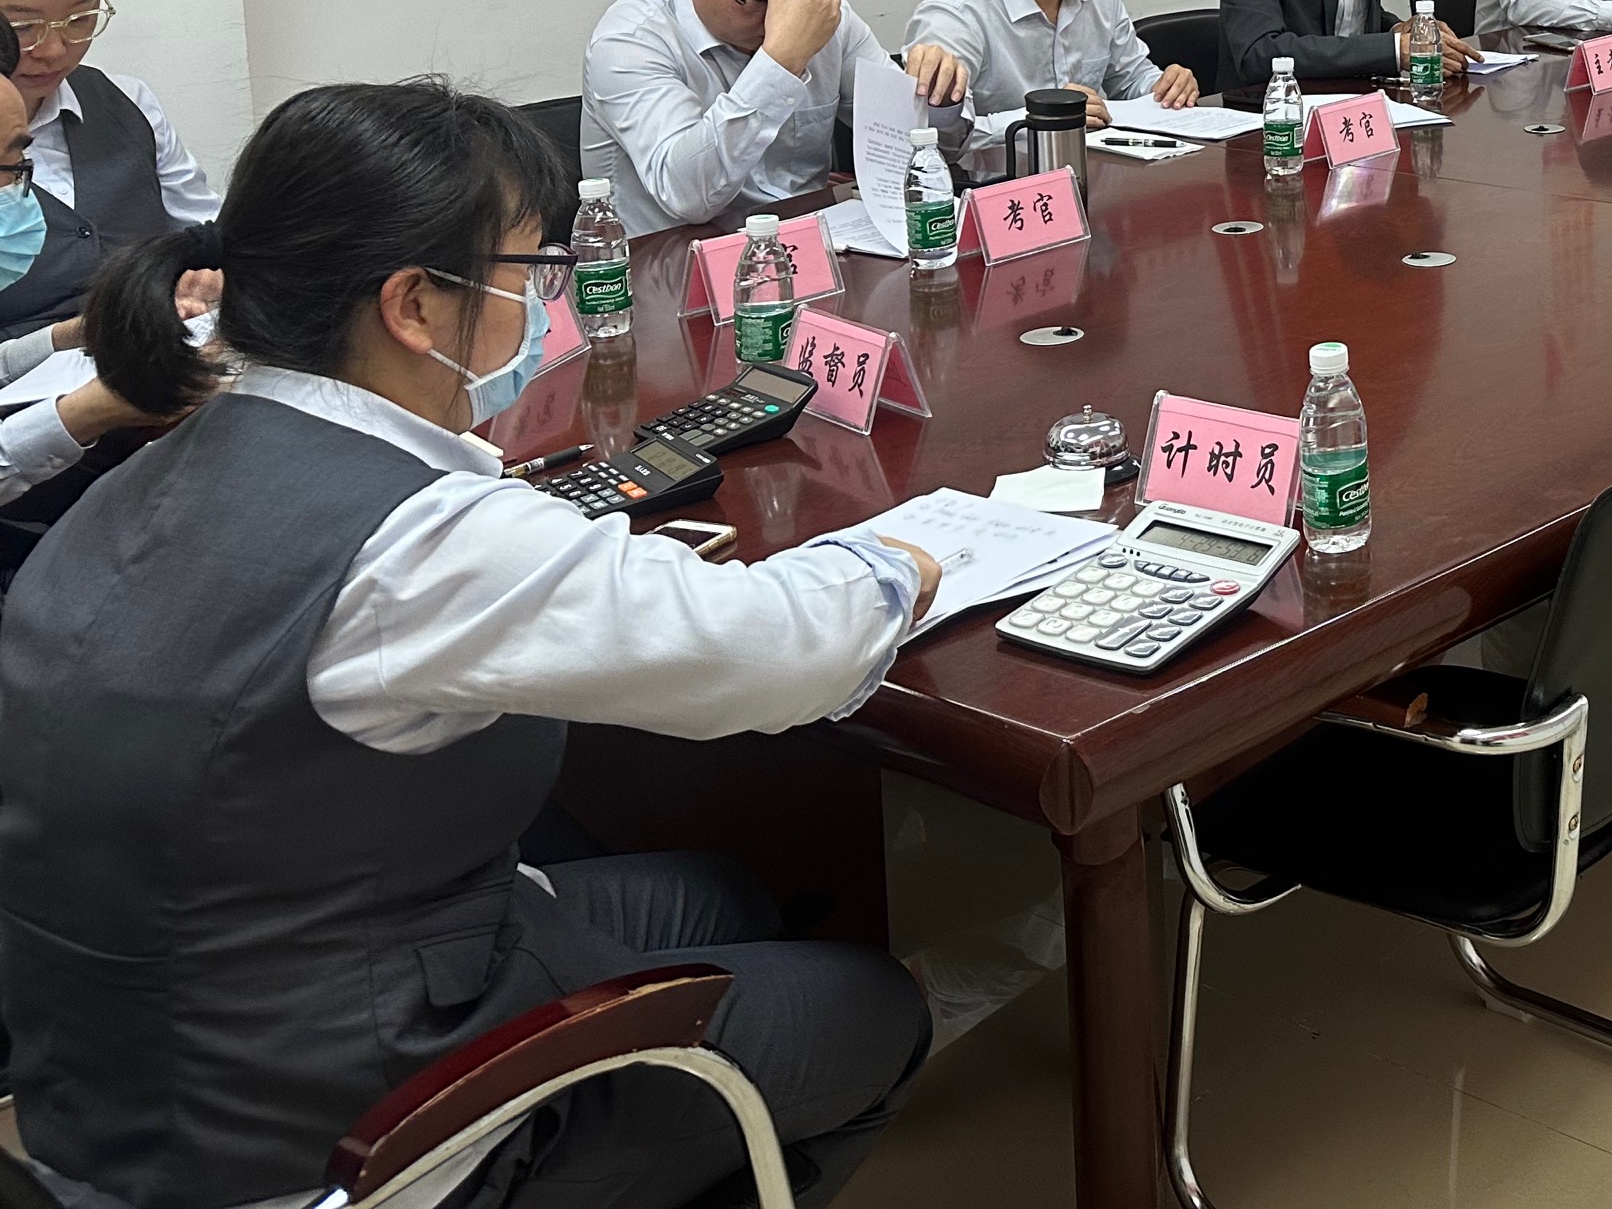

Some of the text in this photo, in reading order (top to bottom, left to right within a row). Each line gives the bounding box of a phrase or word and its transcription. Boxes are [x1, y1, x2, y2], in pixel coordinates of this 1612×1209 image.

[1339, 111, 1375, 143] 考官
[1003, 193, 1054, 231] 考官
[797, 336, 869, 398] 监督员
[1160, 430, 1280, 496] 计时员
